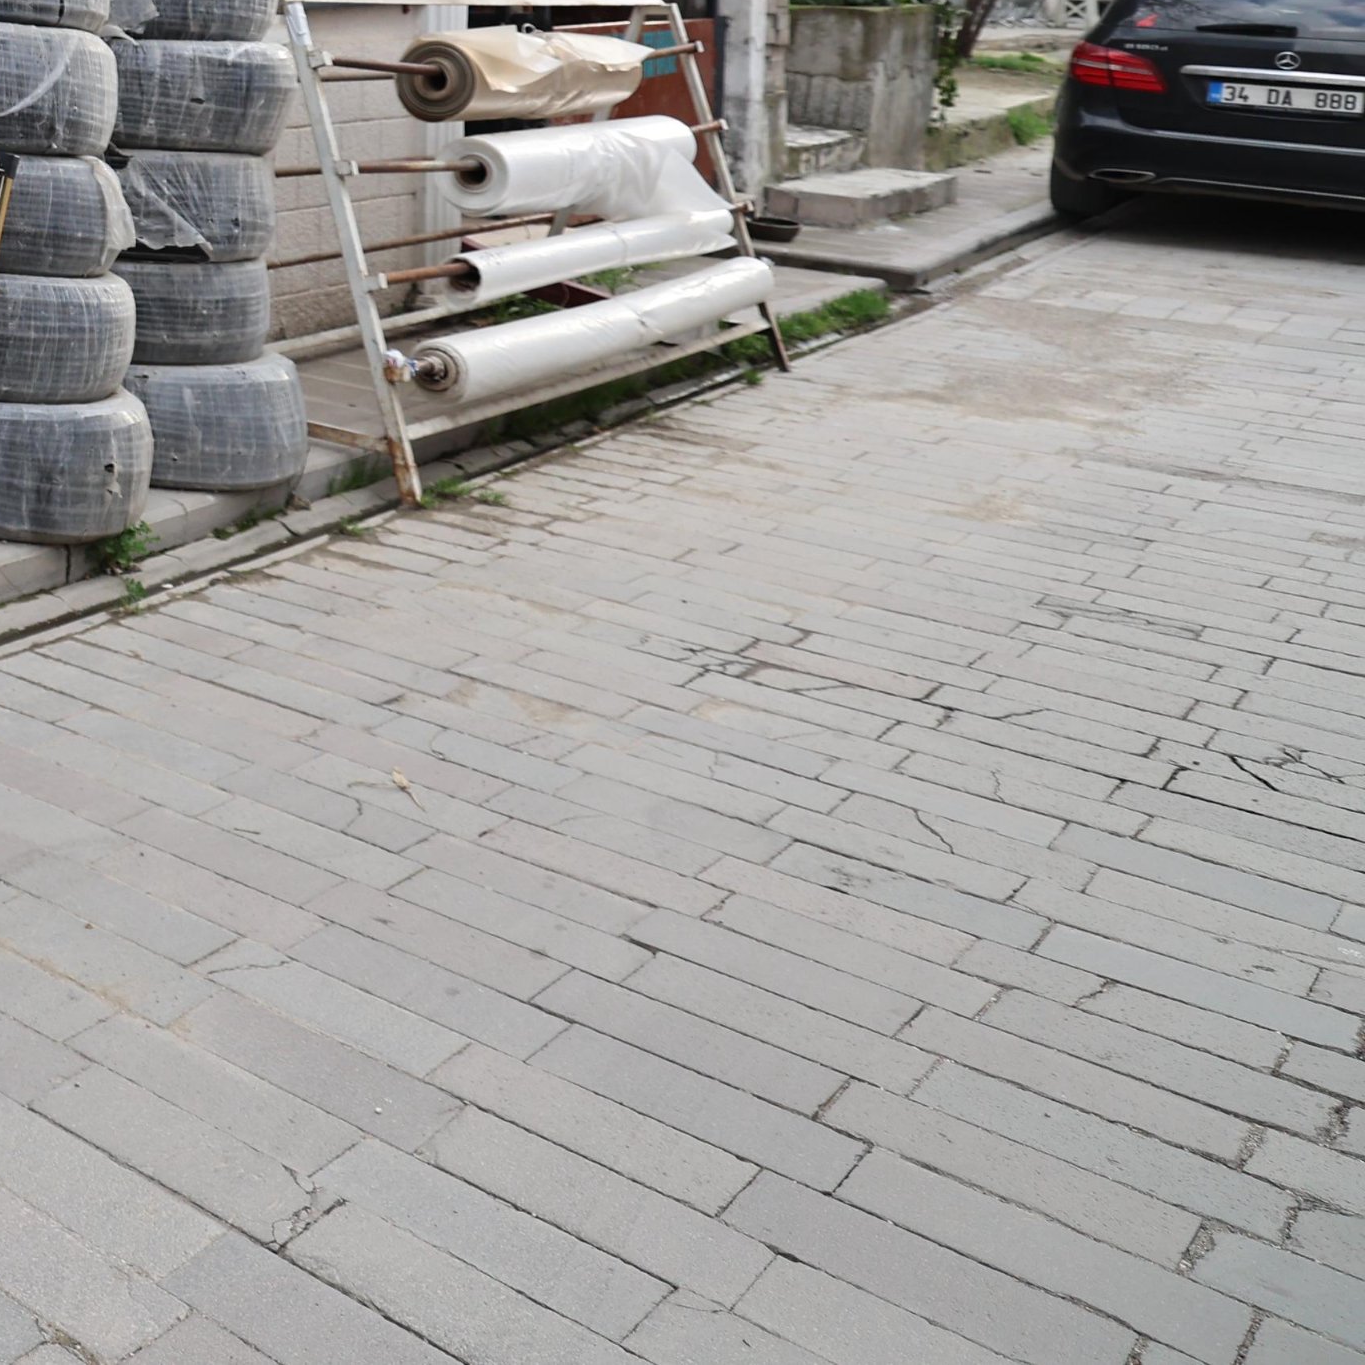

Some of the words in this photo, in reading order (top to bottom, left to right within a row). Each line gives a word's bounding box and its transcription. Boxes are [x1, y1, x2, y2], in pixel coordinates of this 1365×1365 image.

[1223, 84, 1250, 103] 34
[1266, 87, 1293, 107] DA
[1315, 92, 1358, 111] 888
